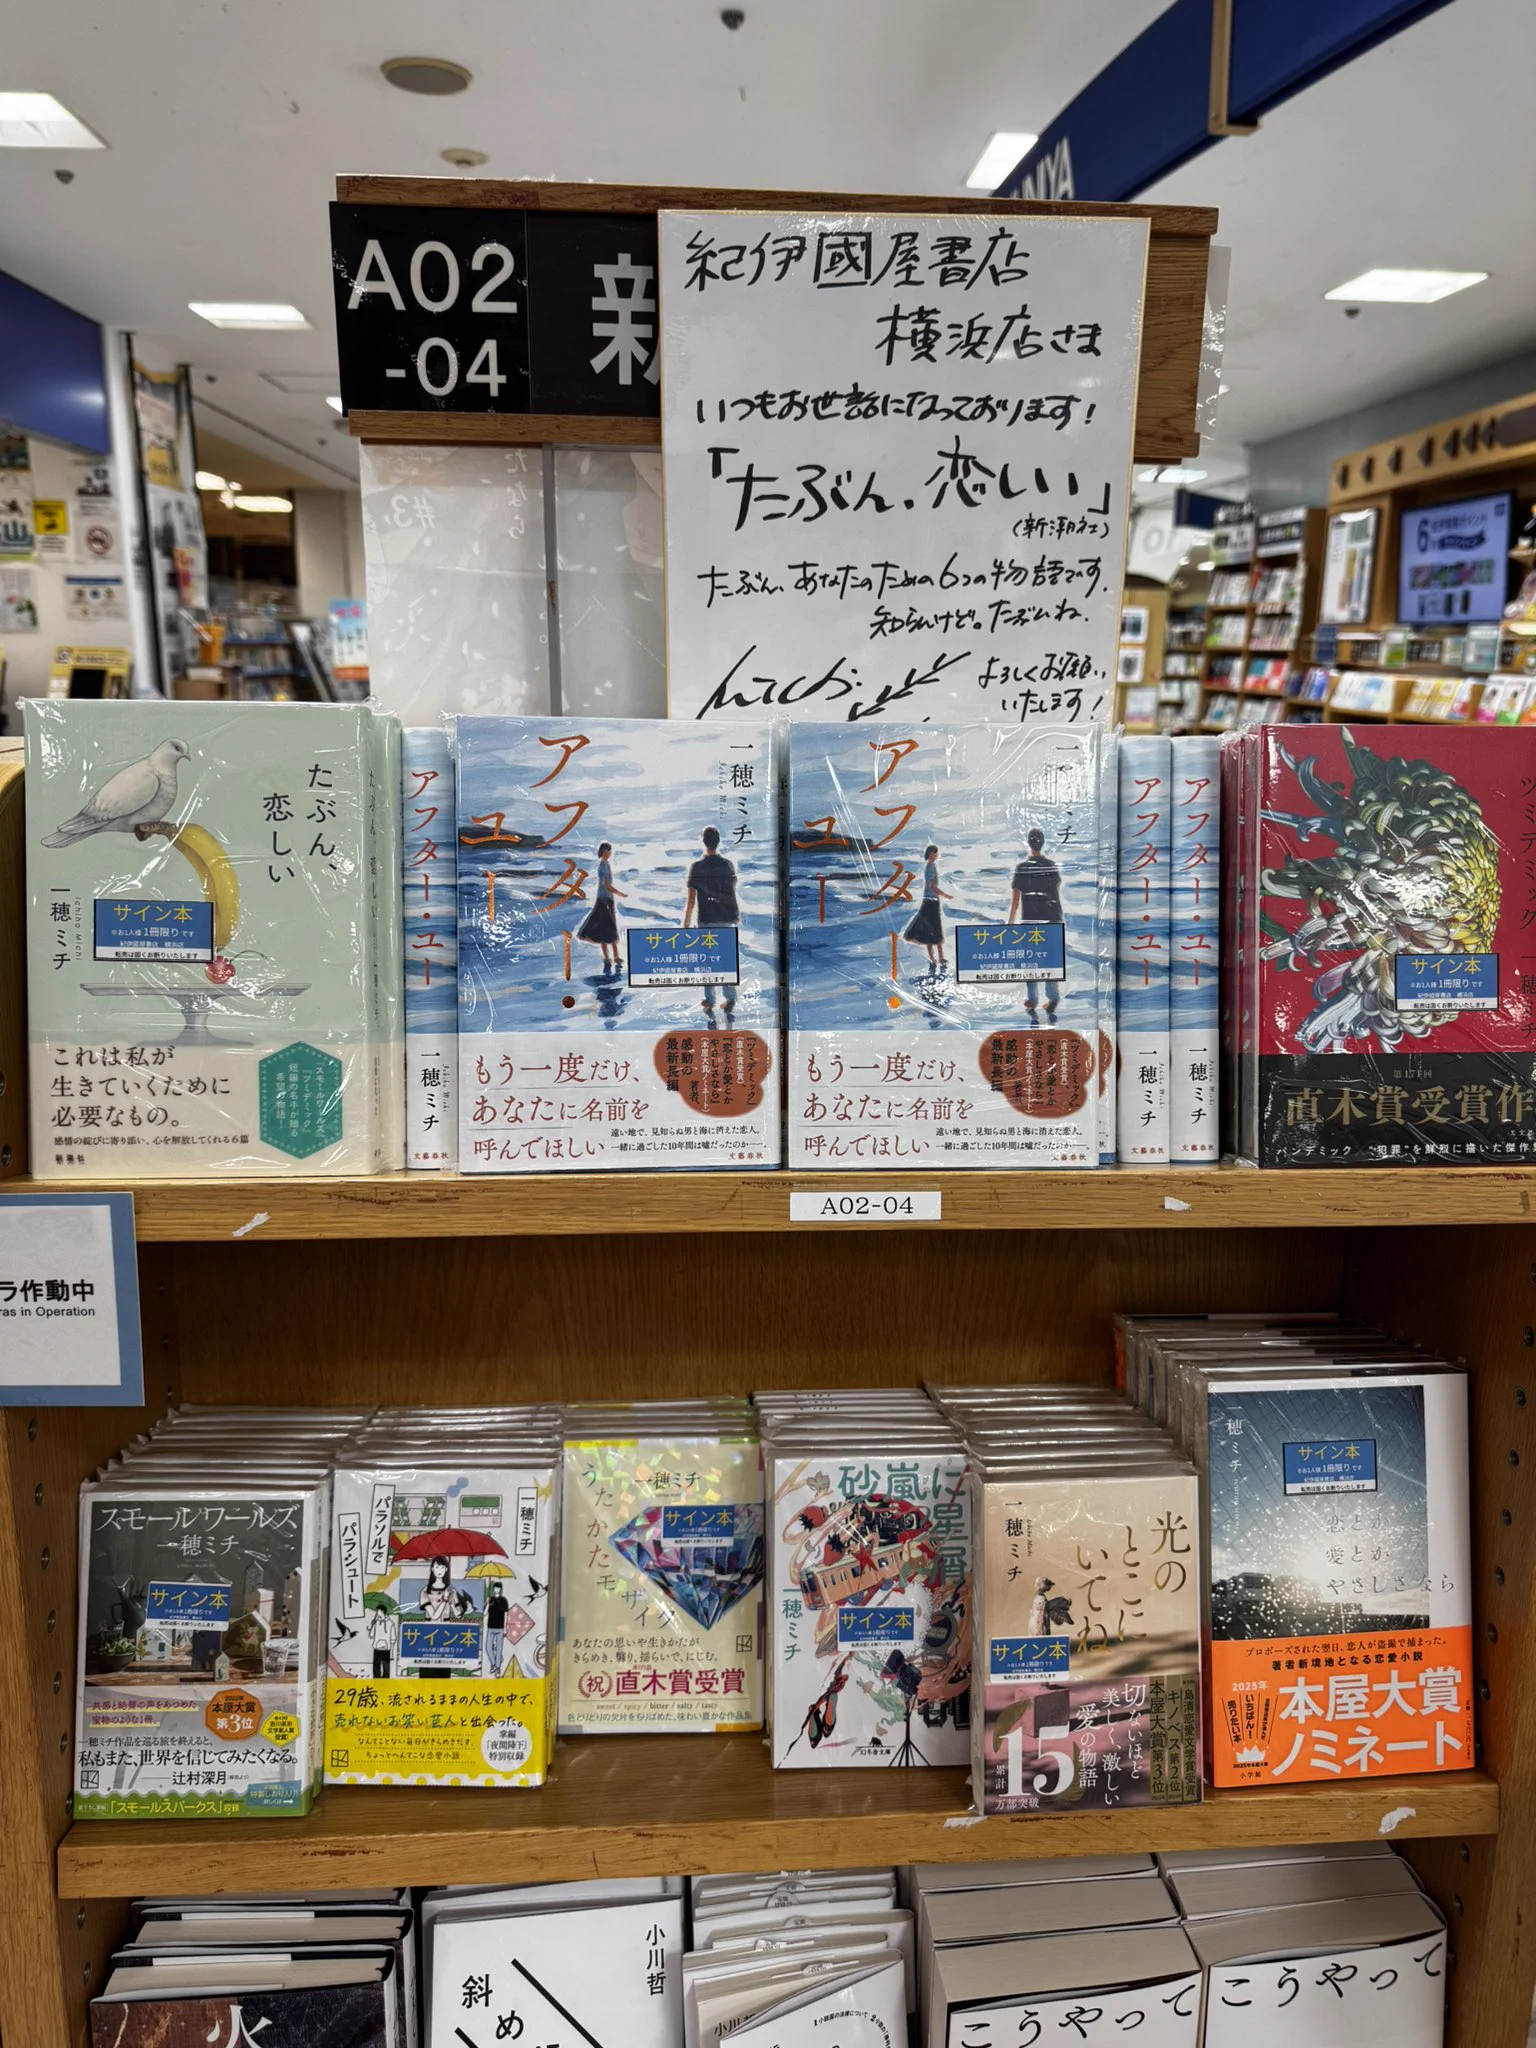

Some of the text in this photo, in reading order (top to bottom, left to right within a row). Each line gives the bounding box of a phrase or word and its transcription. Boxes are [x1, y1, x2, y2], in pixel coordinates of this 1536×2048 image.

[684, 227, 1031, 291] 紀伊國屋書店
[347, 239, 518, 313] A02
[875, 304, 1102, 366] 横浜店さま
[385, 337, 507, 397] -04
[729, 743, 755, 845] 一穂ミチ
[263, 792, 296, 883] 恋しい
[408, 769, 444, 987] アフター・ユー
[1129, 777, 1162, 987] アフター・ユー
[1179, 777, 1212, 987] アフター・ユー
[113, 904, 193, 924] サイン本
[50, 887, 72, 970] 一穂ミチ
[645, 930, 720, 949] サイン本
[973, 927, 1046, 945] サイン本
[1411, 956, 1481, 976] サイン本
[52, 1046, 175, 1066] これは私が
[476, 1052, 641, 1085] もう一度だけ、
[807, 1052, 966, 1083] もう一度だけ、
[51, 1076, 231, 1097] 生きていくために
[420, 1053, 441, 1132] 一穂ミチ
[1138, 1050, 1158, 1128] 一穂ミチ
[1188, 1047, 1208, 1125] 一穂ミチ
[51, 1105, 181, 1128] 必要なもの。
[472, 1099, 649, 1125] あなたに名前を
[803, 1094, 974, 1122] あなたに名前を
[474, 1137, 604, 1161] 呼んでほしい
[804, 1135, 930, 1158] 呼んでほしい
[820, 1196, 914, 1215] A02-04
[21, 1306, 31, 1317] in
[35, 1306, 96, 1319] Operation
[1226, 1405, 1243, 1473] 一穂ミチ
[1298, 1444, 1360, 1461] サイン本
[635, 1471, 701, 1490] 一穂ミチ
[838, 1461, 961, 1501] 砂嵐に
[95, 1506, 300, 1532] スモールワールズ
[371, 1495, 392, 1564] パラソルで
[519, 1495, 536, 1551] 一穂ミチ
[665, 1508, 734, 1526] サイン本
[157, 1533, 240, 1556] 一穂ミチ
[1005, 1501, 1024, 1583] 一穂ミチ
[1151, 1511, 1191, 1593] 光の
[1326, 1546, 1390, 1565] 愛とか
[341, 1521, 360, 1609] パラシュート
[151, 1588, 229, 1609] サイン本
[1326, 1574, 1455, 1596] やさしさなら
[782, 1588, 804, 1662] 一穂ミチ
[840, 1611, 912, 1630] サイン本
[403, 1628, 478, 1647] サイン本
[572, 1636, 700, 1649] あなたの思いや生きかたが
[992, 1641, 1067, 1662] サイン本
[1271, 1652, 1423, 1671] 著者新境地となる恋愛小説
[616, 1667, 746, 1696] 直木賞受賞
[1231, 1680, 1268, 1692] 2025年
[1279, 1665, 1462, 1724] 本屋大賞
[212, 1701, 256, 1714] 本屋大賞
[334, 1685, 534, 1709] 29歳、流されるままの人生の中で、
[216, 1713, 254, 1734] 第3位
[334, 1713, 524, 1729] 売れないお笑い芸人と出会った。
[1123, 1682, 1147, 1780] 切ないほど
[1076, 1703, 1101, 1788] 愛の物語
[1149, 1679, 1166, 1793] 本屋大賞第3位
[1271, 1720, 1463, 1776] ノミネート
[489, 1751, 525, 1761] 特別収録
[998, 1721, 1075, 1797] 15
[171, 1771, 228, 1786] 辻村深月
[995, 1799, 1040, 1810] 万部突破
[645, 1924, 667, 1996] 小川哲
[1221, 1942, 1443, 2007] こうやって
[960, 1984, 1197, 2048] こうやって
